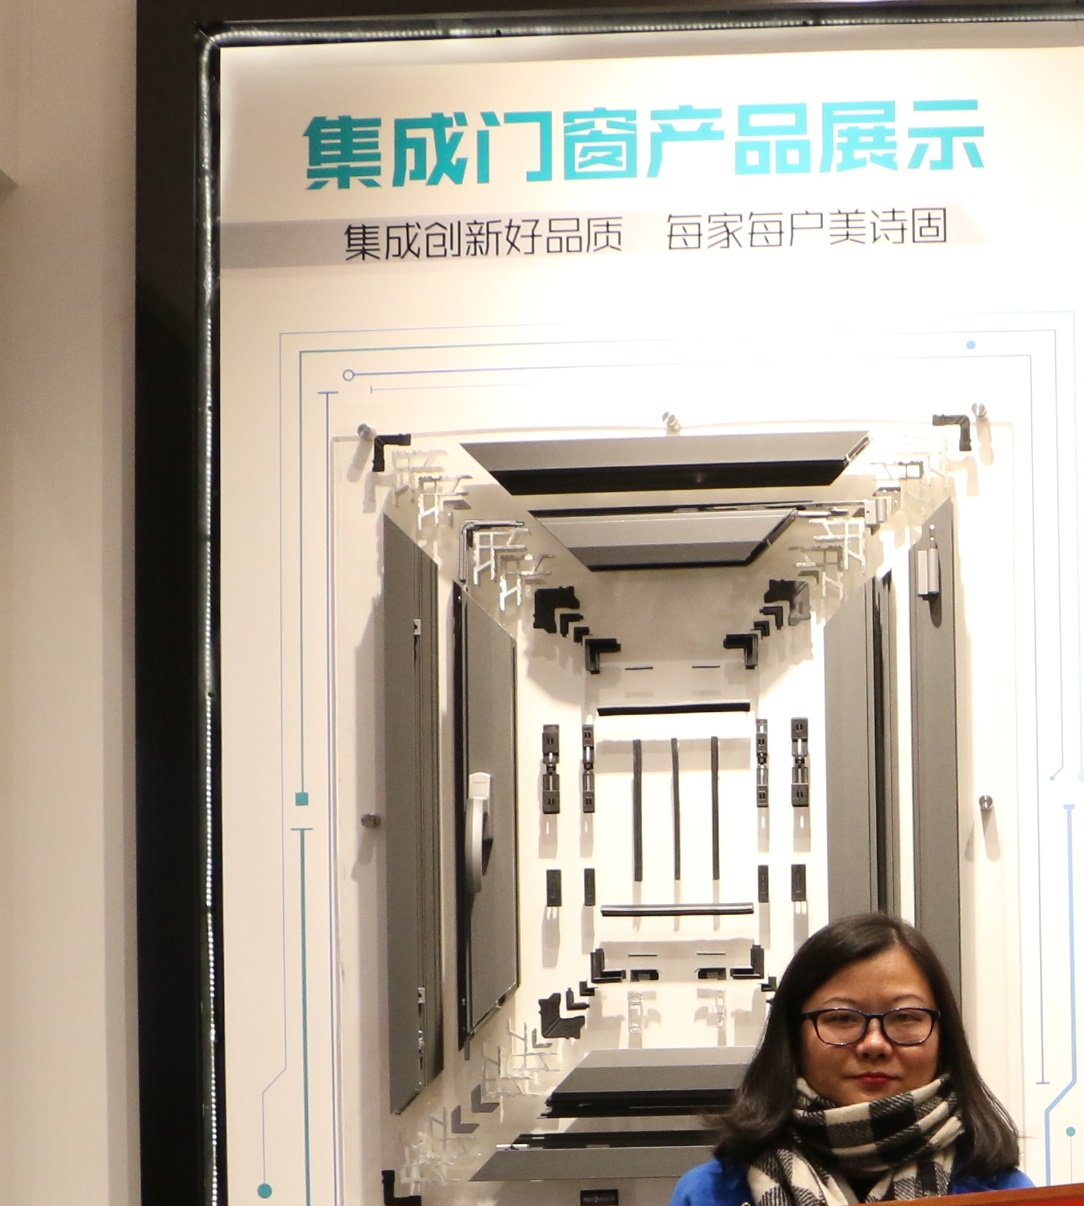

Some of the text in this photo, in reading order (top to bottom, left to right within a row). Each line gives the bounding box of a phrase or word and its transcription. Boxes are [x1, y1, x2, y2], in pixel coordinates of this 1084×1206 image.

[303, 100, 985, 191] 集成门窗产品展示
[343, 206, 948, 262] 集成创新好品质 每家每户美诗固
